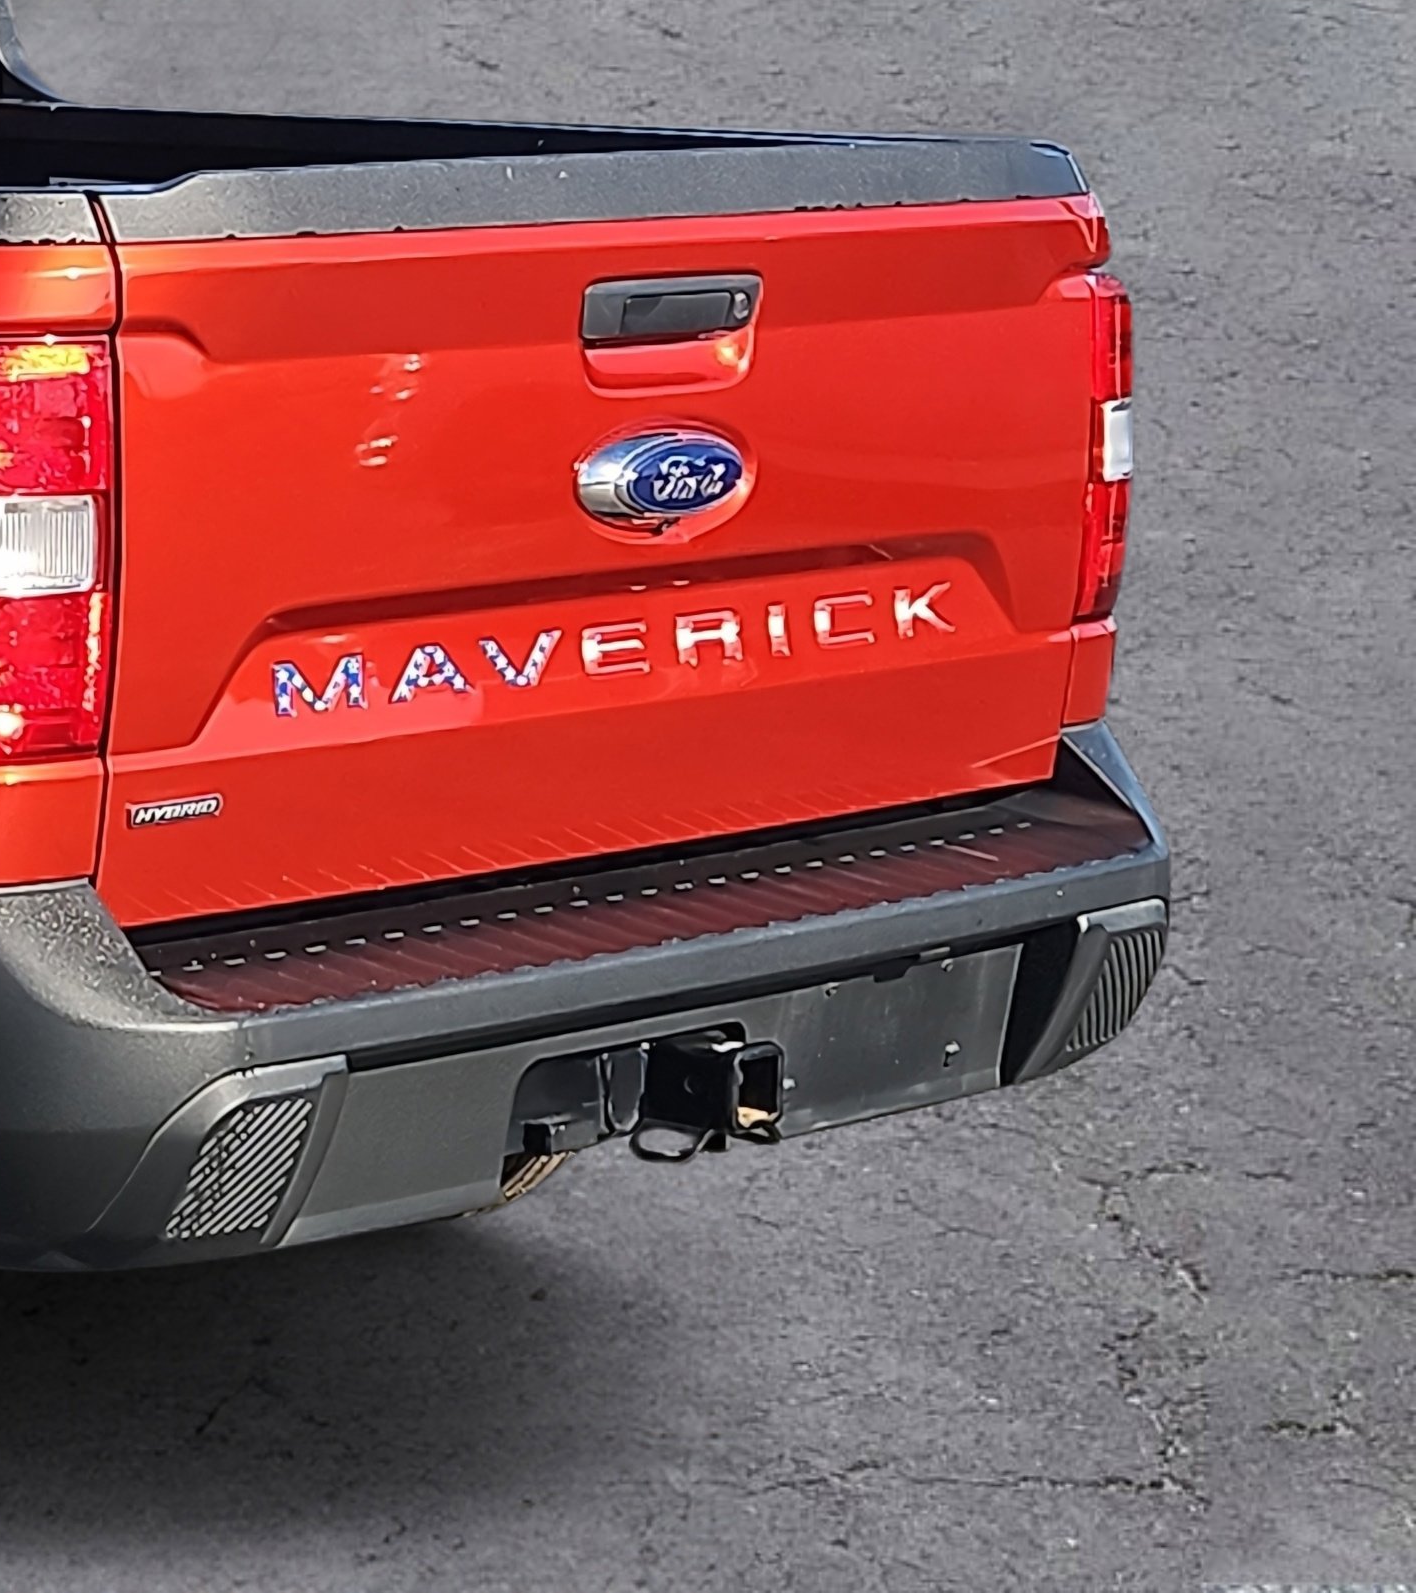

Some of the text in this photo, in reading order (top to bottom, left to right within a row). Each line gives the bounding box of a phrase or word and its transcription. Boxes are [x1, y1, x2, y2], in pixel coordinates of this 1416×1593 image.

[652, 454, 727, 503] Ford
[270, 581, 956, 719] MAVERICK
[133, 798, 219, 824] HYBRID
